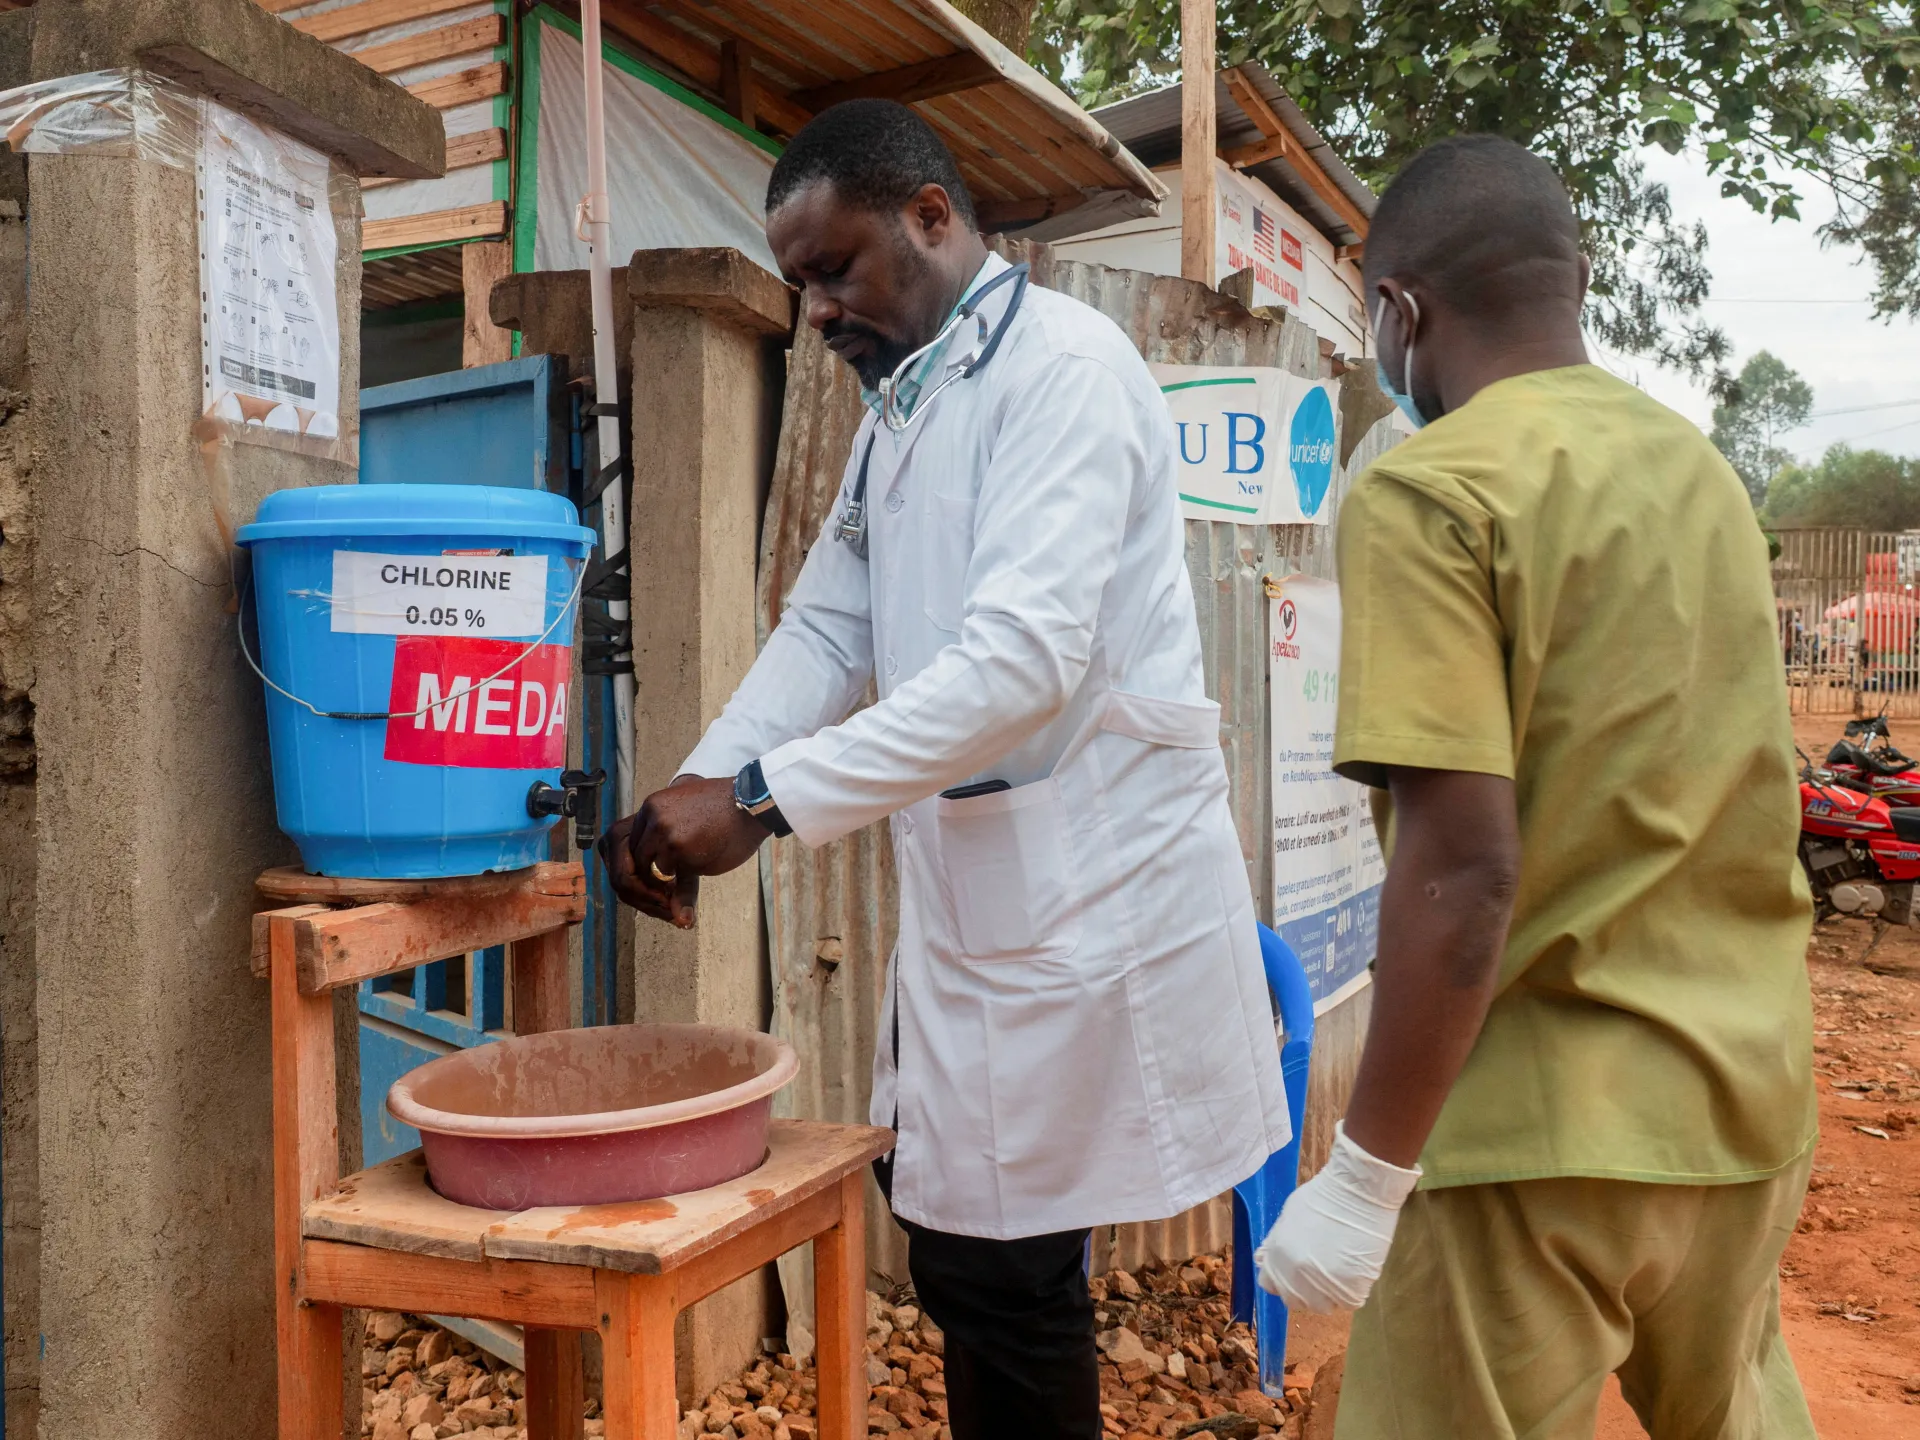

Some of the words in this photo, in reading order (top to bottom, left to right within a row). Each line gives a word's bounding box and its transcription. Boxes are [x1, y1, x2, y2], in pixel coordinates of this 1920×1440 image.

[1228, 242, 1243, 270] ZONE
[1291, 438, 1320, 463] unicef
[1238, 480, 1263, 495] New
[380, 564, 512, 591] CHLORINE
[405, 605, 459, 627] 0.05
[464, 608, 486, 628] %
[1303, 668, 1319, 702] 49
[1804, 798, 1833, 816] AG
